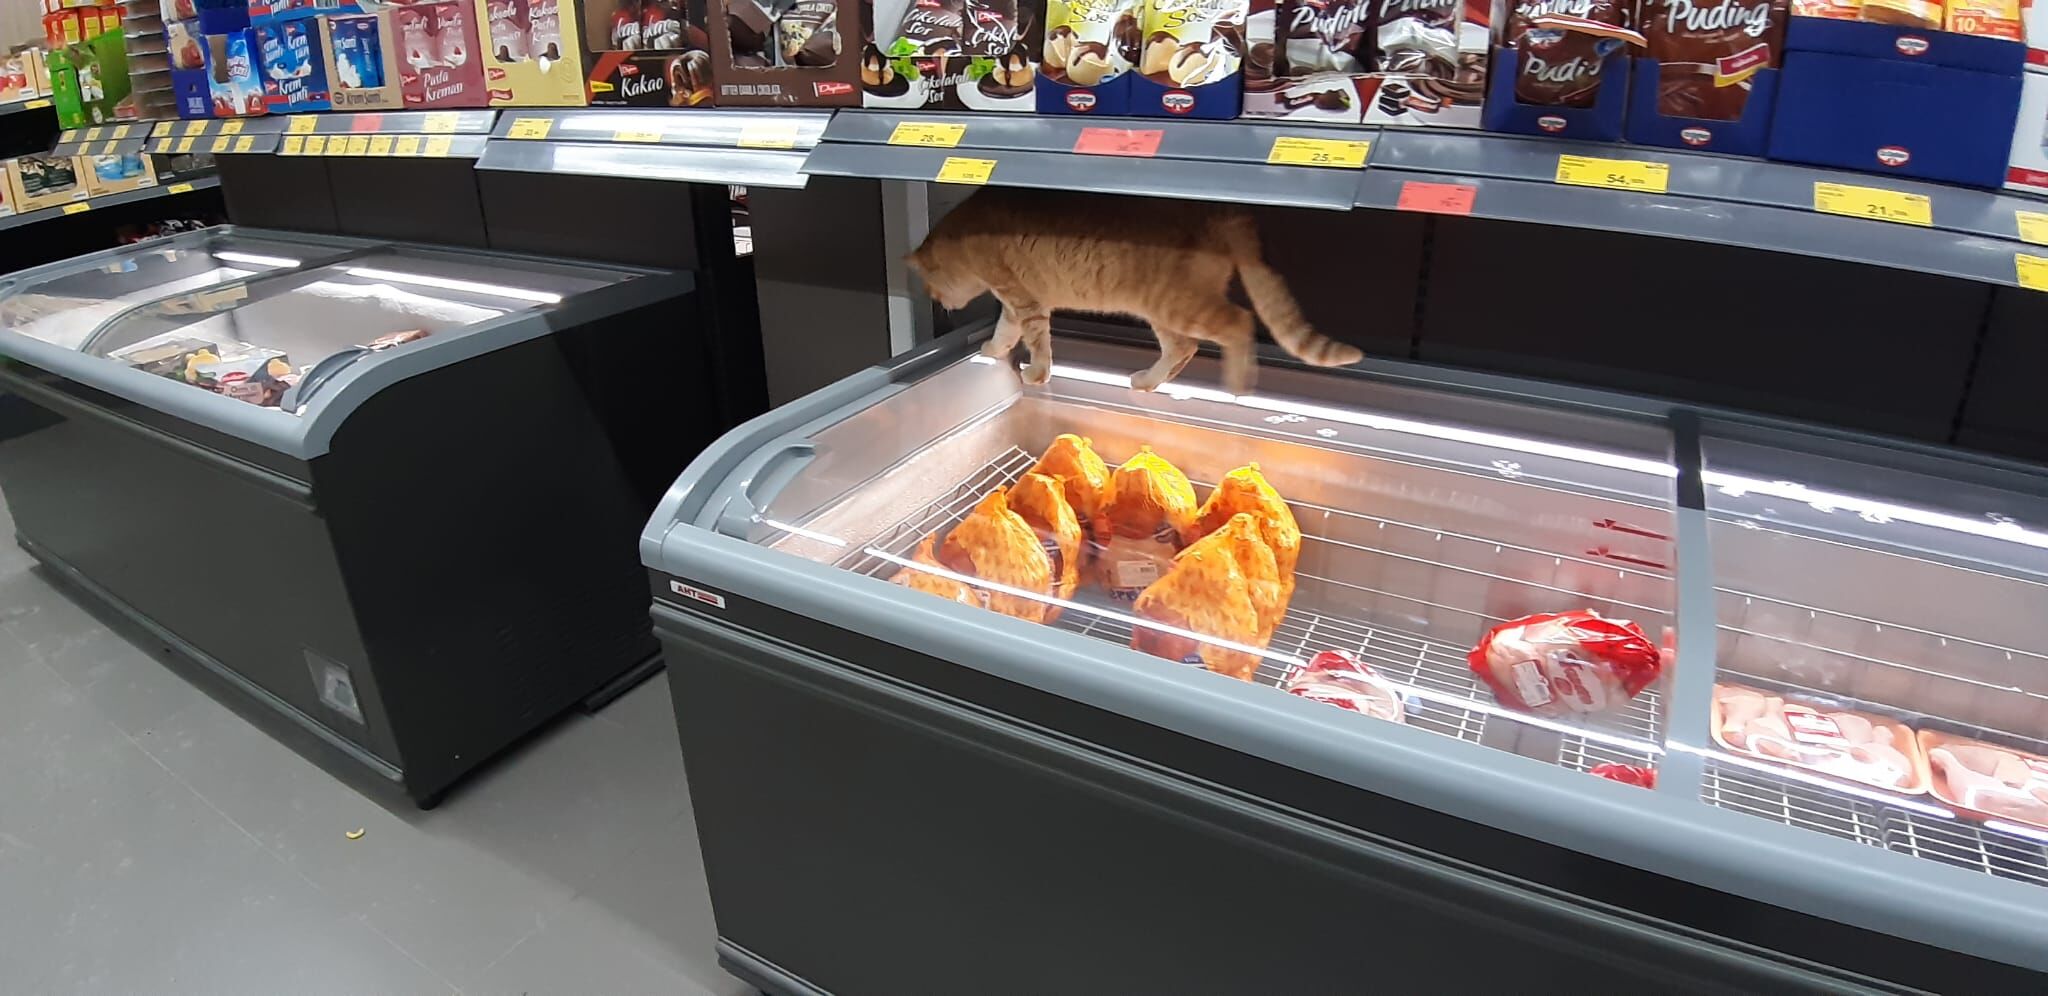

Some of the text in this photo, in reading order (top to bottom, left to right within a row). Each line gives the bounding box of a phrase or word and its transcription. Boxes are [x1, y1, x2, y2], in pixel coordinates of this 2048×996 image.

[1663, 0, 1771, 37] Puding
[1955, 16, 1976, 33] 10
[620, 74, 664, 98] Kakao
[676, 584, 698, 598] AHT
